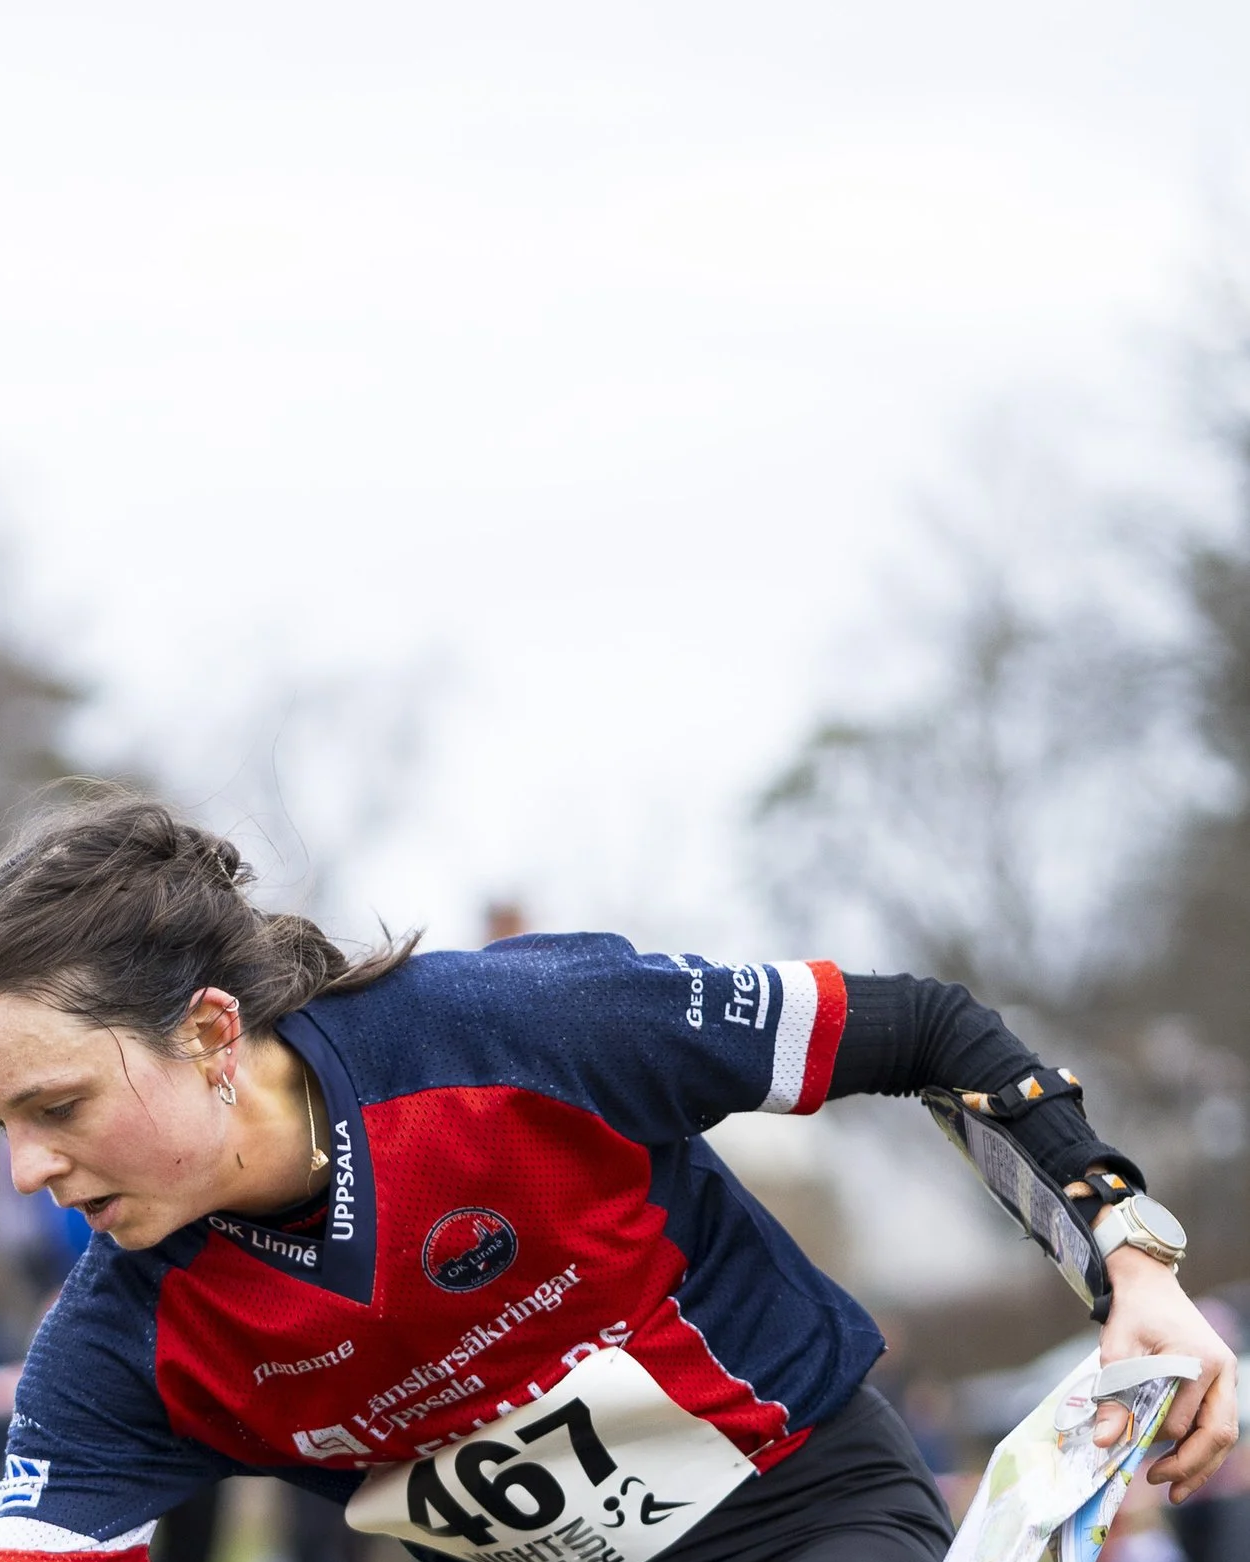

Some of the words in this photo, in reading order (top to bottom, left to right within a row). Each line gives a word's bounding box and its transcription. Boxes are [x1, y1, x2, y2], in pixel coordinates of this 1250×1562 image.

[332, 1119, 355, 1240] UPPSALA
[208, 1216, 245, 1239] OK
[251, 1230, 317, 1268] Linné
[351, 1262, 583, 1430] Länsförsäkringar
[368, 1374, 487, 1443] Uppsala
[406, 1396, 618, 1546] 467
